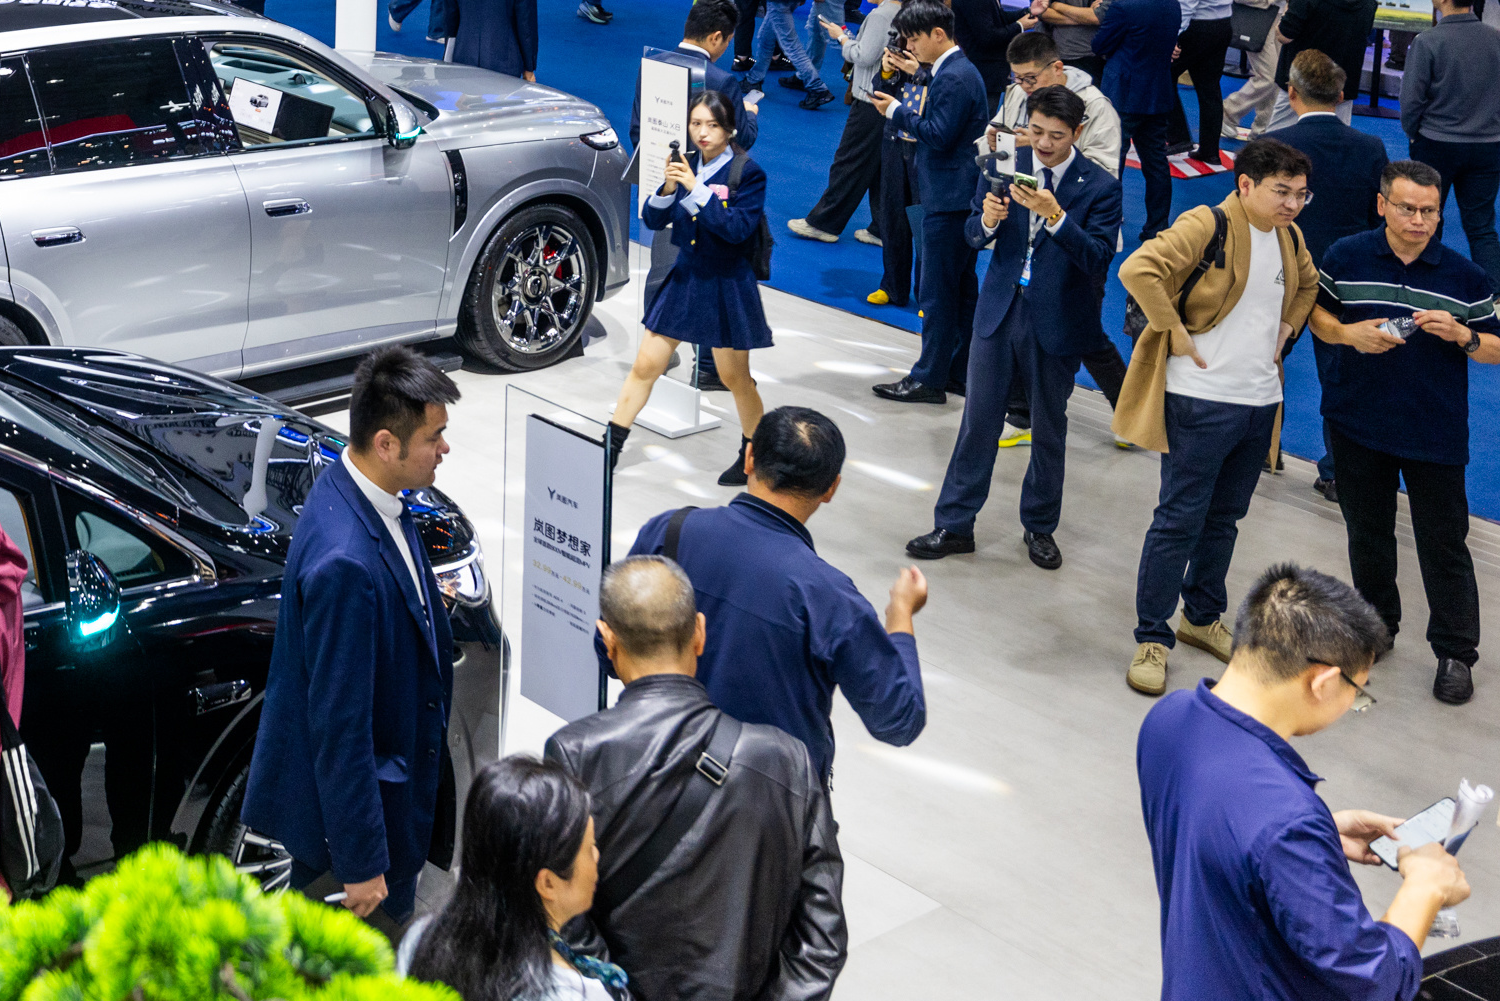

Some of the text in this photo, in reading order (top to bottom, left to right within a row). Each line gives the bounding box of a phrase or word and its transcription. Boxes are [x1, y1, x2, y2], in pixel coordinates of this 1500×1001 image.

[669, 122, 681, 132] X8
[534, 517, 591, 557] 岚图梦想家
